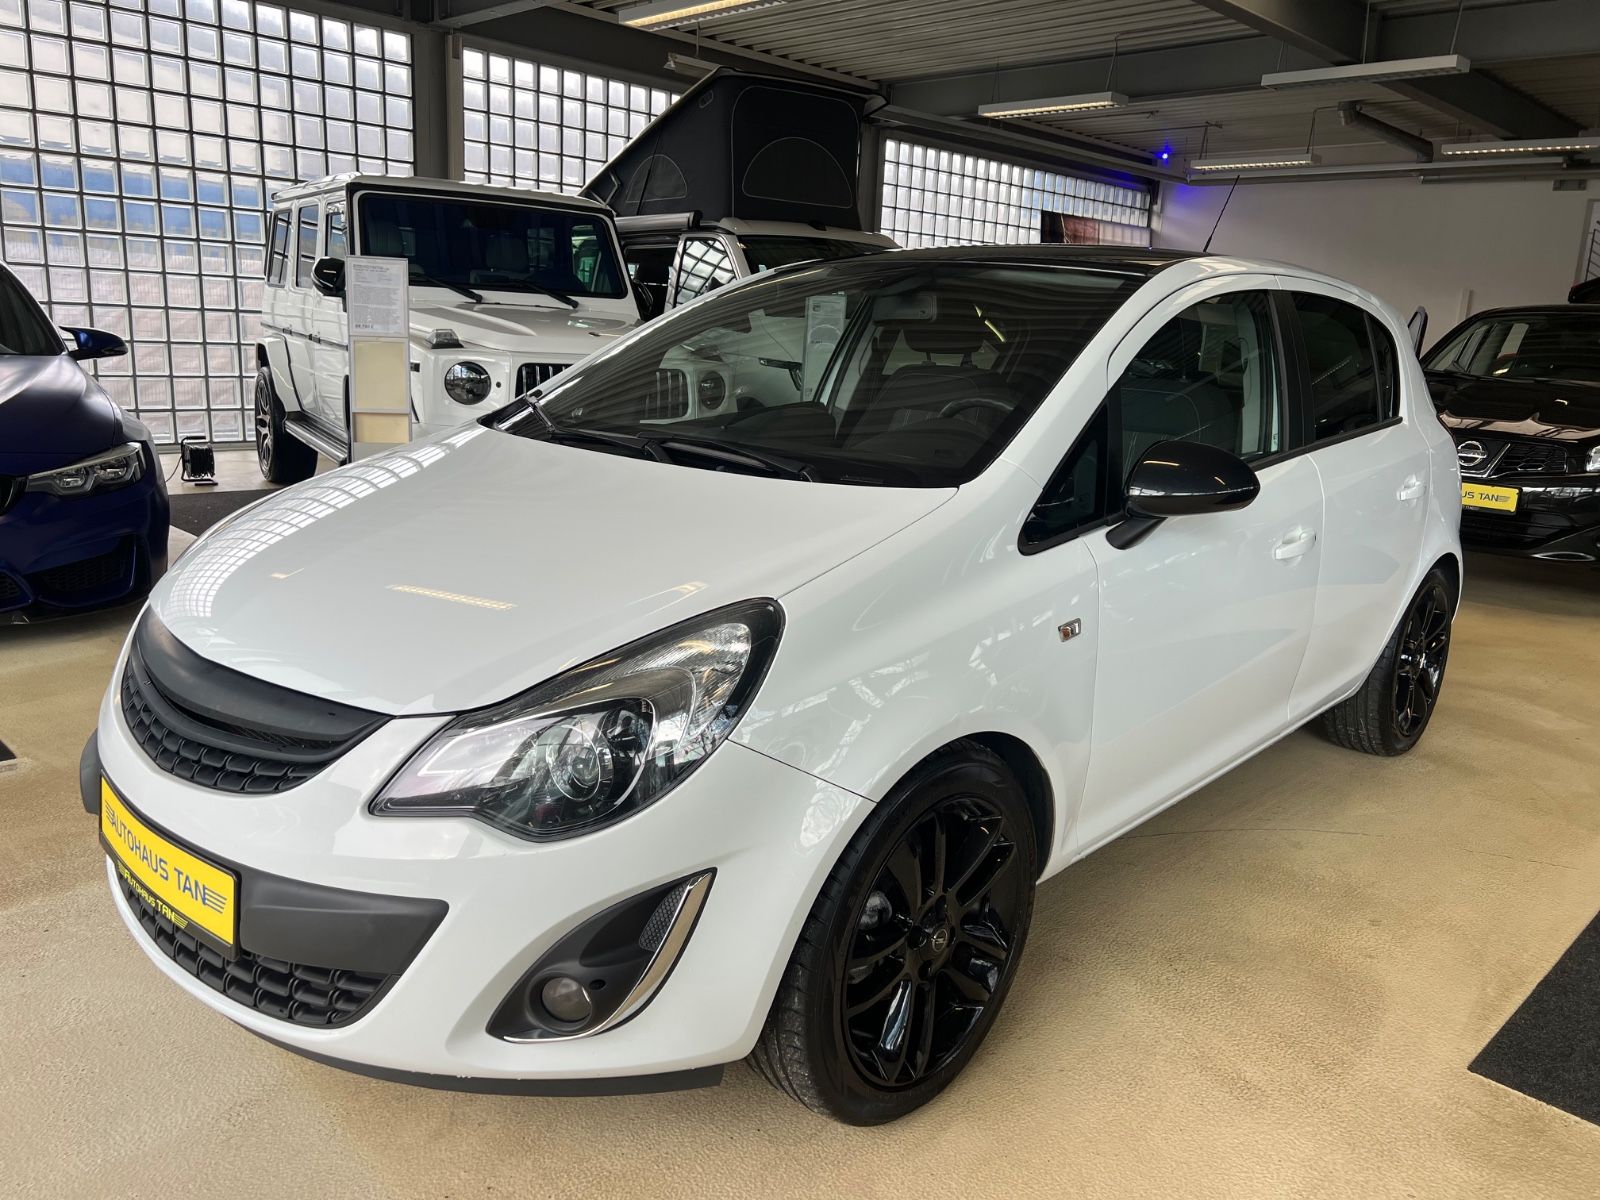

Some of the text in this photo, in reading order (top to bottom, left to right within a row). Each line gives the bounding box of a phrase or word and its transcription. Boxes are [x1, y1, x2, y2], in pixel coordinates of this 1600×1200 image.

[1478, 492, 1499, 502] TAN
[111, 810, 208, 907] AUTOHAUS TAN
[124, 870, 175, 923] AUTOHAUS TAN
